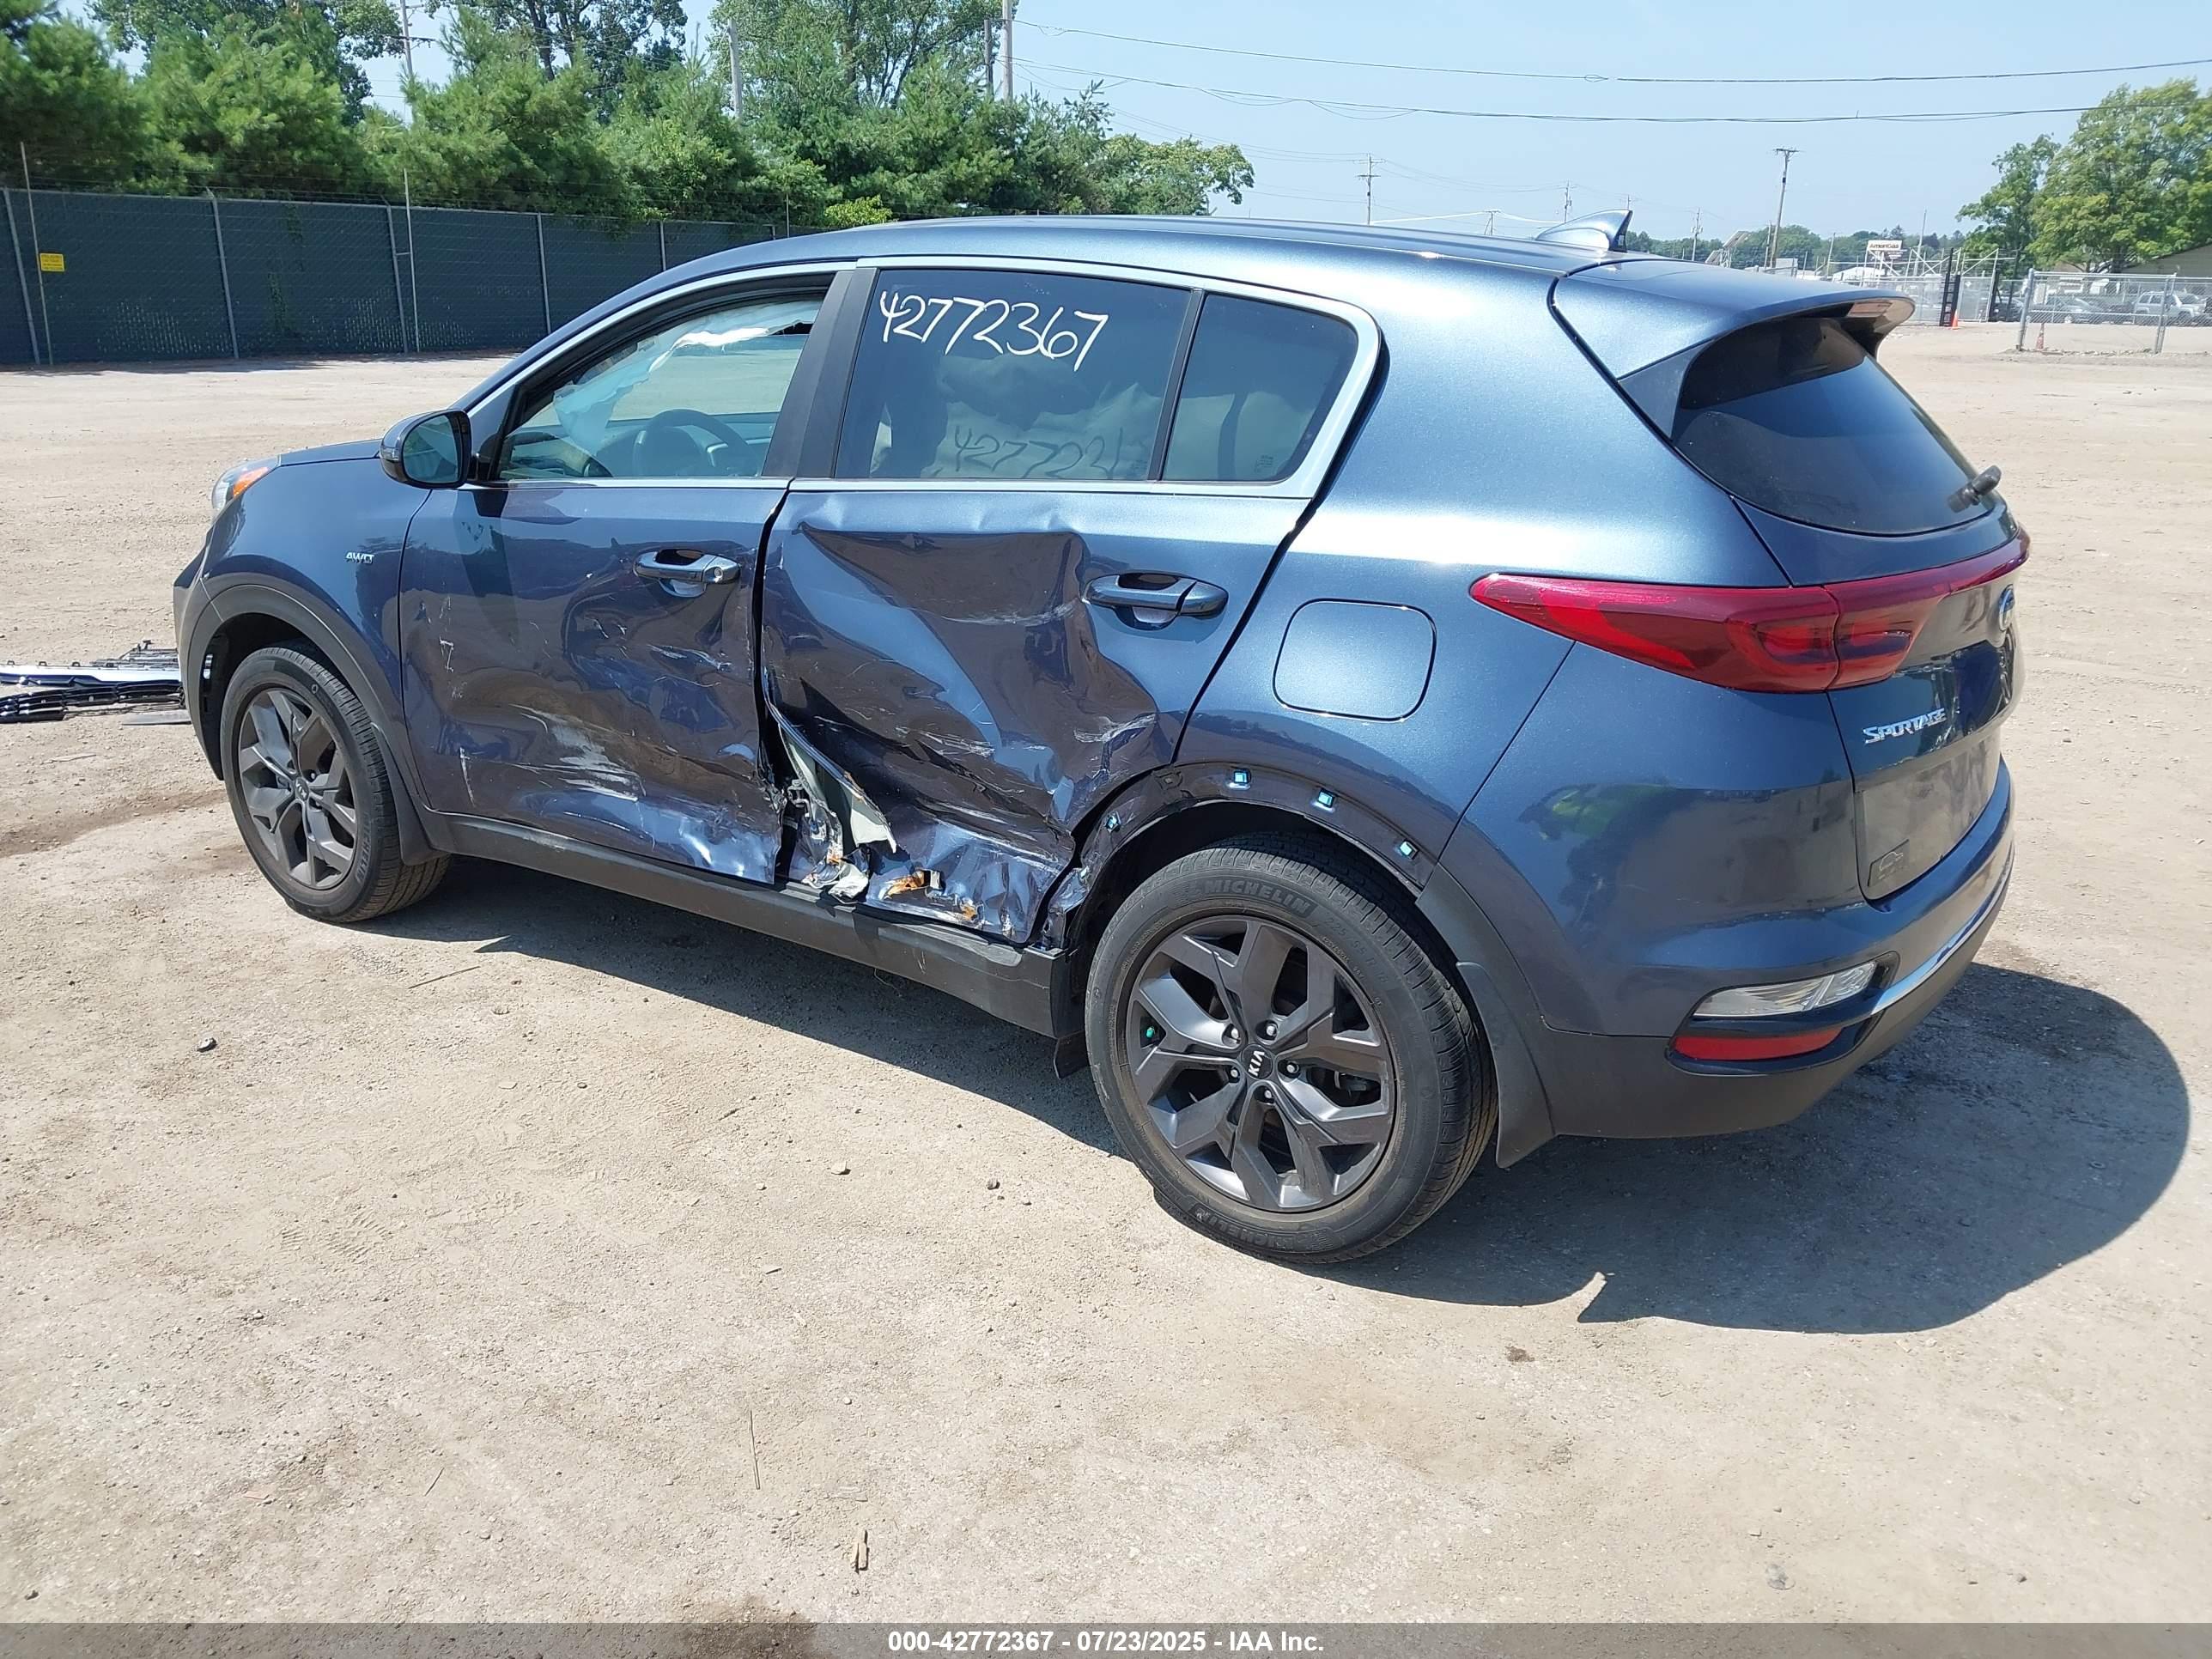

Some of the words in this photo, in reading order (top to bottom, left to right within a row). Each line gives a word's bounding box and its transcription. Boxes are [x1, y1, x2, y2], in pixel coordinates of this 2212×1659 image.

[879, 290, 1109, 372] 42772367
[345, 551, 375, 564] AWD
[1862, 708, 1947, 744] SPORTAGE
[1204, 878, 1313, 915] MICHELIN
[1248, 1050, 1265, 1077] KIA
